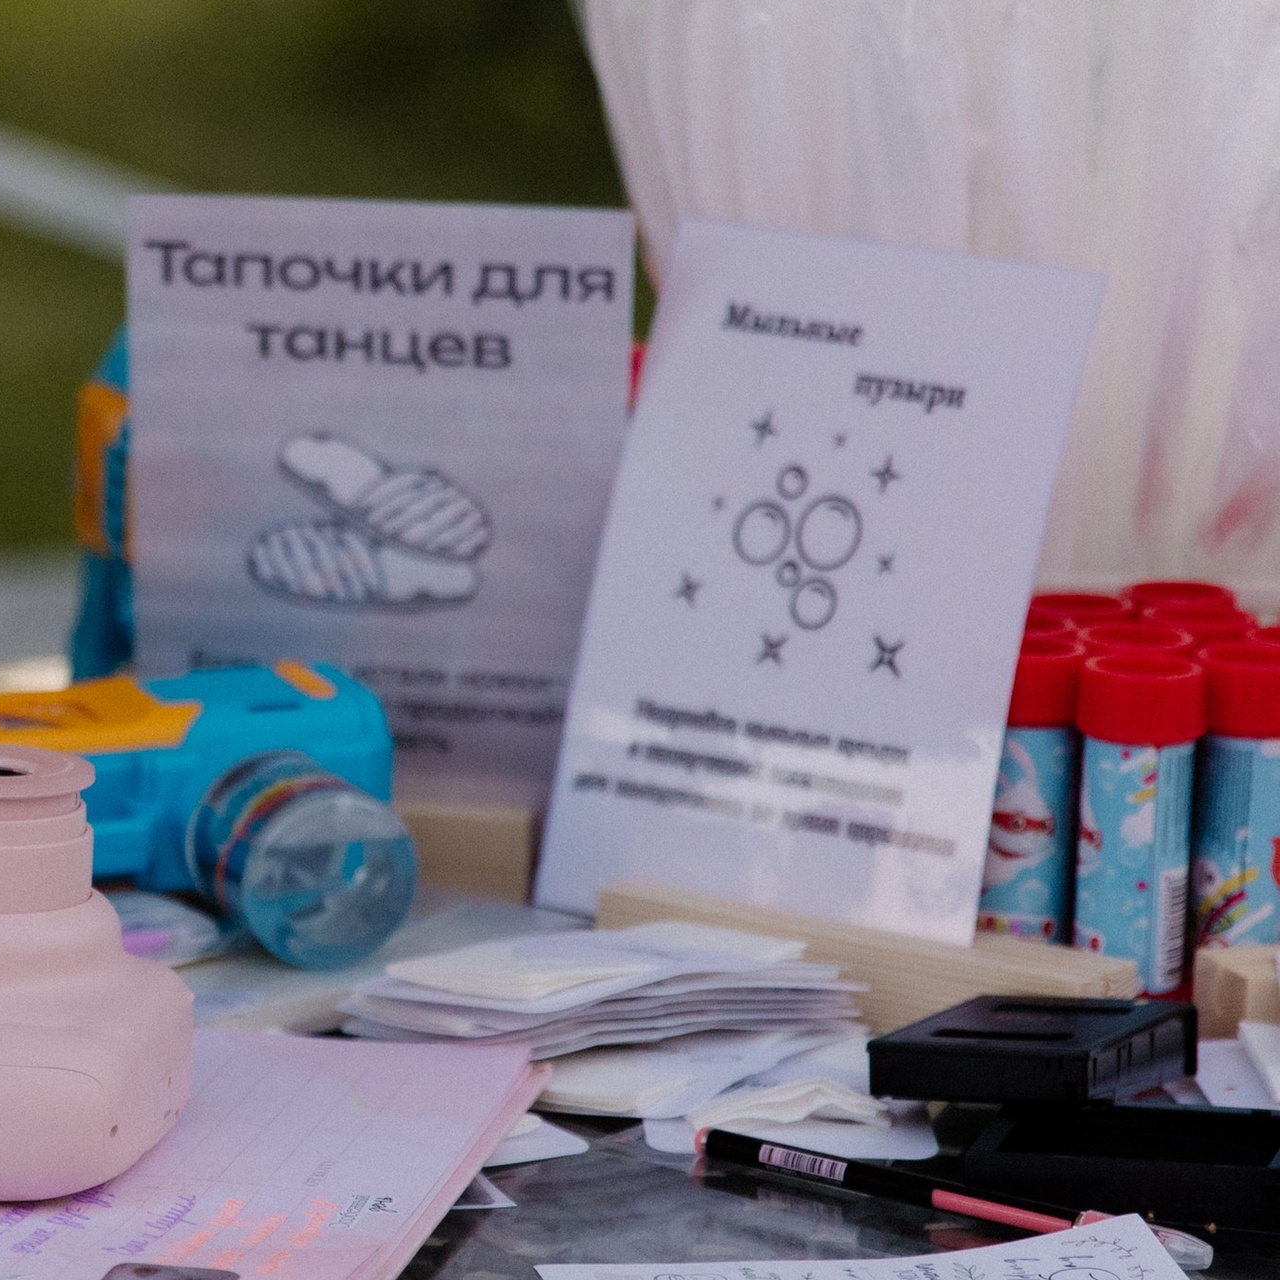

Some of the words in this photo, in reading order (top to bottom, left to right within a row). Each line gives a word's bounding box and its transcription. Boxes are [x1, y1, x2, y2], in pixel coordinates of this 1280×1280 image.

[146, 238, 455, 296] Тапочки
[471, 258, 617, 308] для
[247, 320, 513, 373] танцев
[723, 302, 864, 347] Мыльные
[853, 373, 966, 413] пузыри
